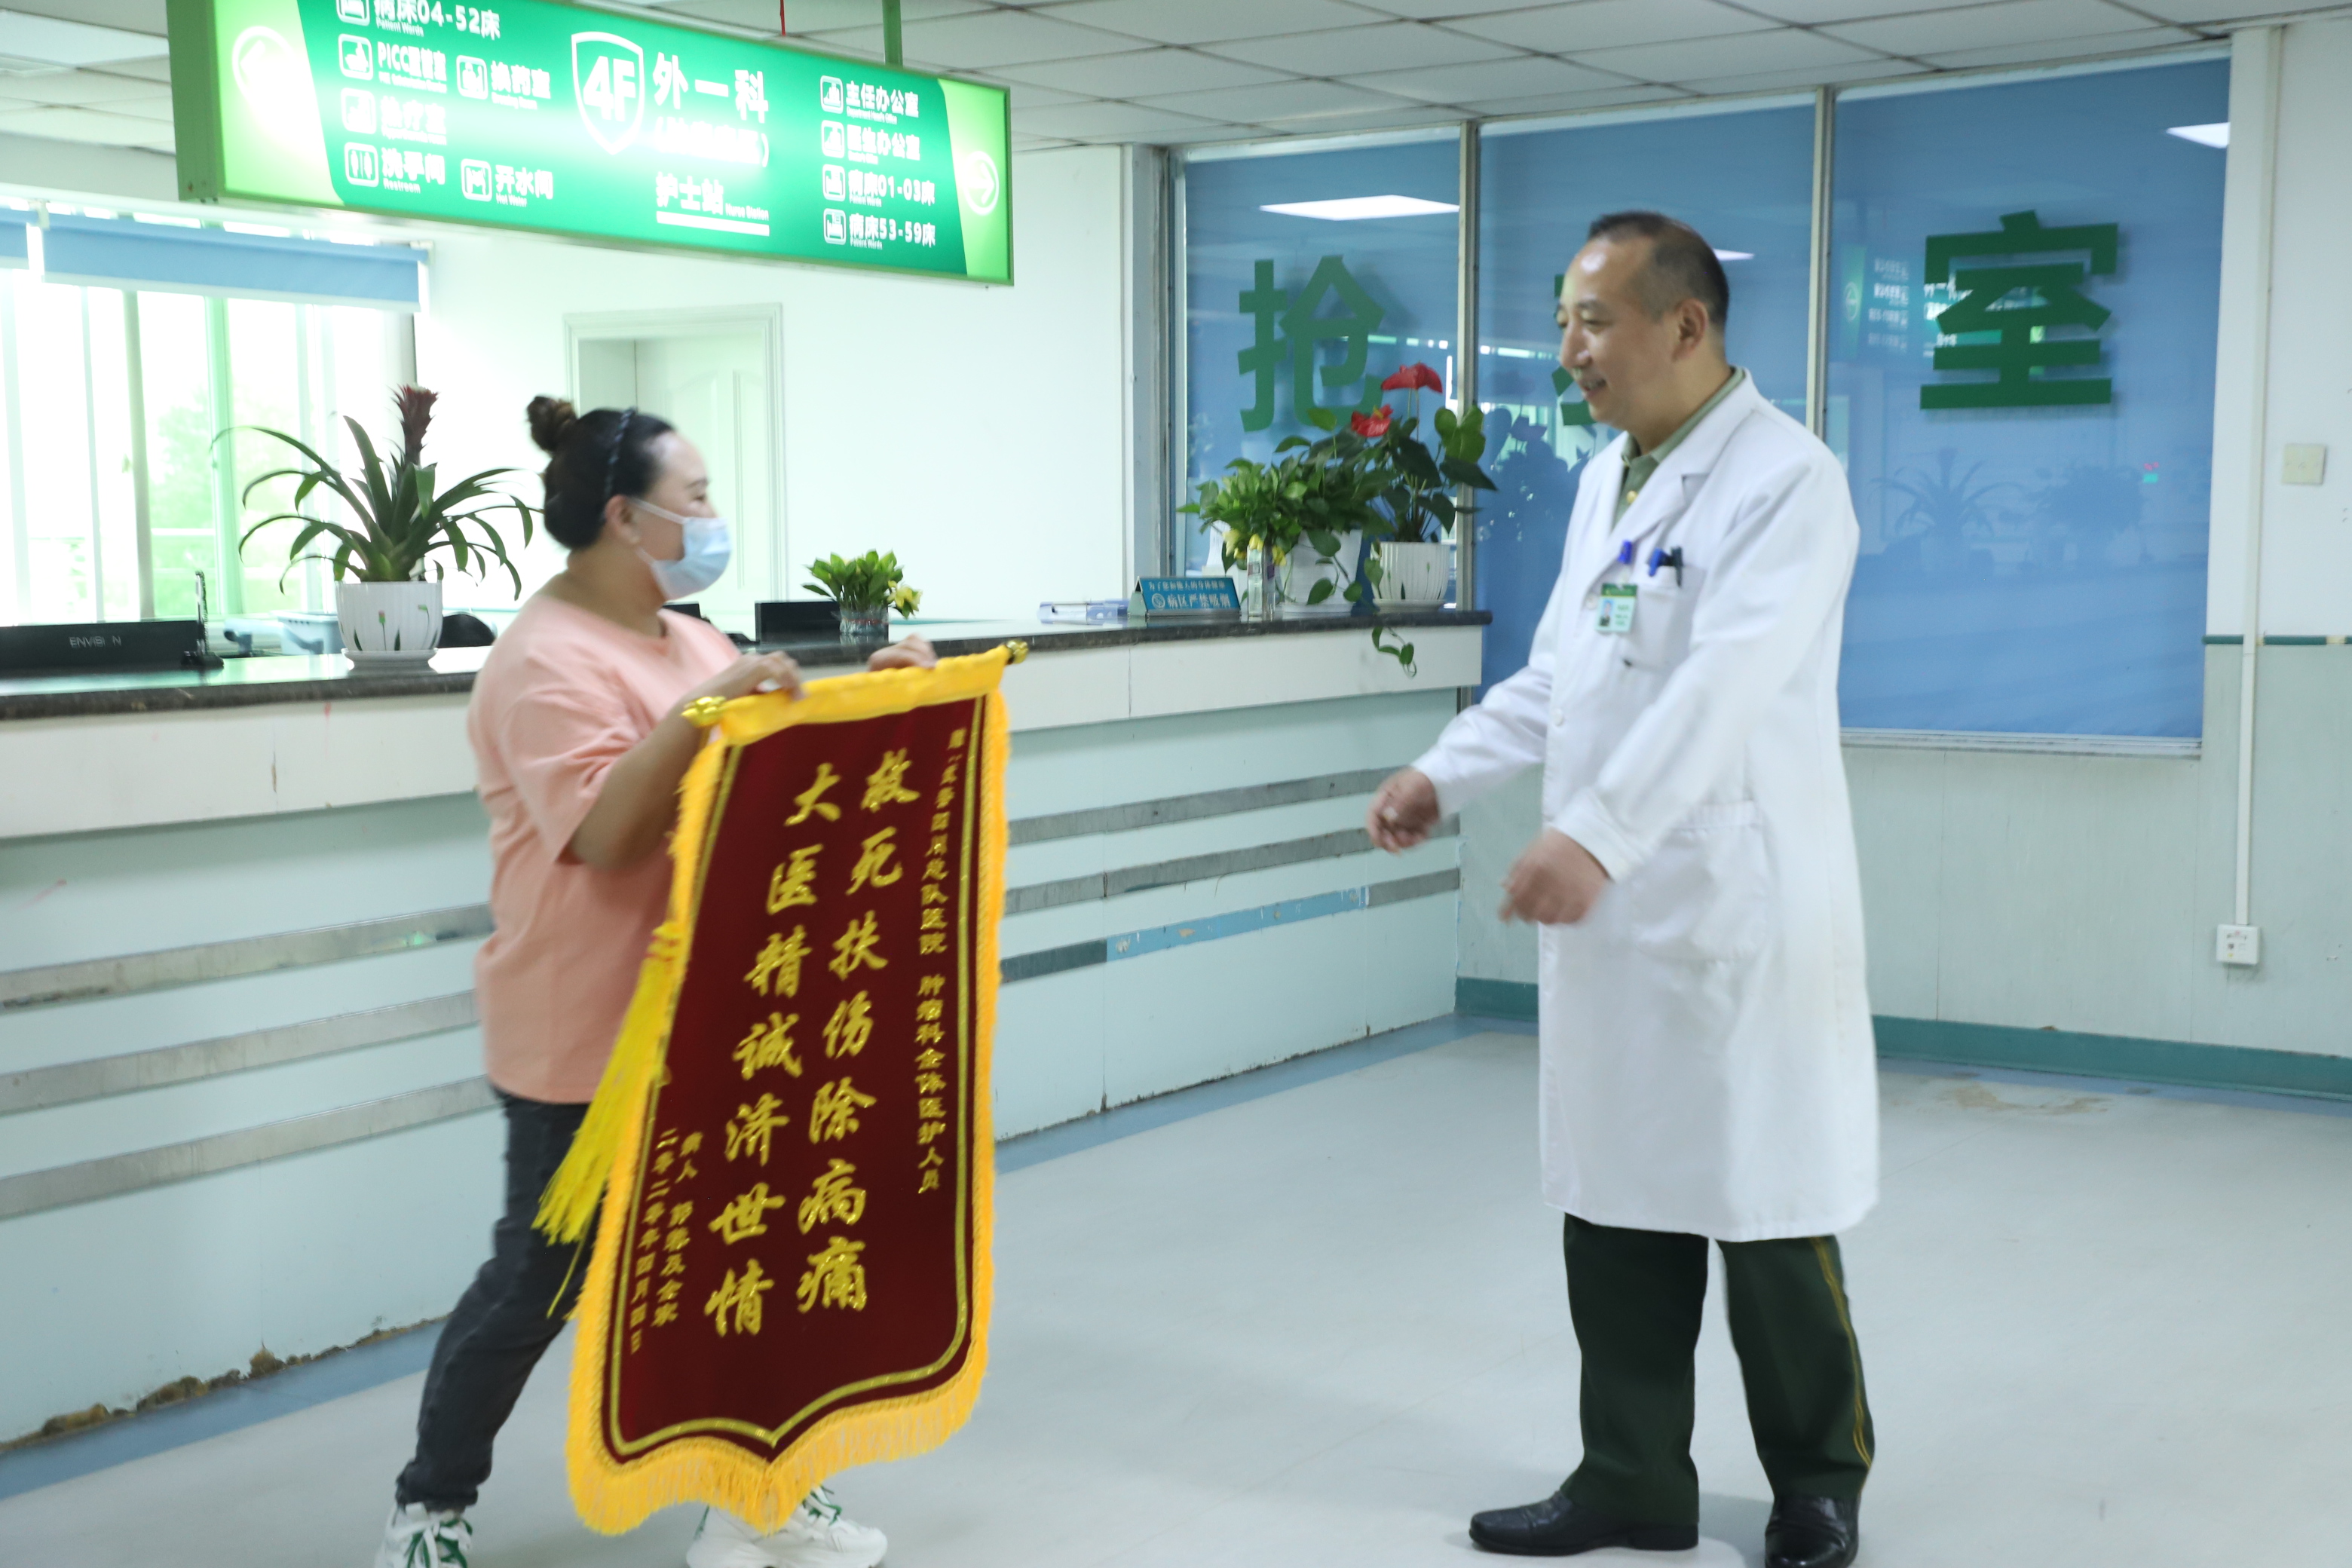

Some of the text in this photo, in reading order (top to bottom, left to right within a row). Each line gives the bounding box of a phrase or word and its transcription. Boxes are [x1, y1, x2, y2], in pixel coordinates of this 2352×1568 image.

[583, 55, 636, 122] 4F
[652, 52, 769, 124] 外一科
[845, 80, 920, 118] 主任办公室
[655, 171, 724, 216] 护士站
[849, 212, 936, 249] 病床53-59床
[704, 762, 842, 1337] 大医精诚济世情
[796, 747, 920, 1314] 救死扶伤除病痛
